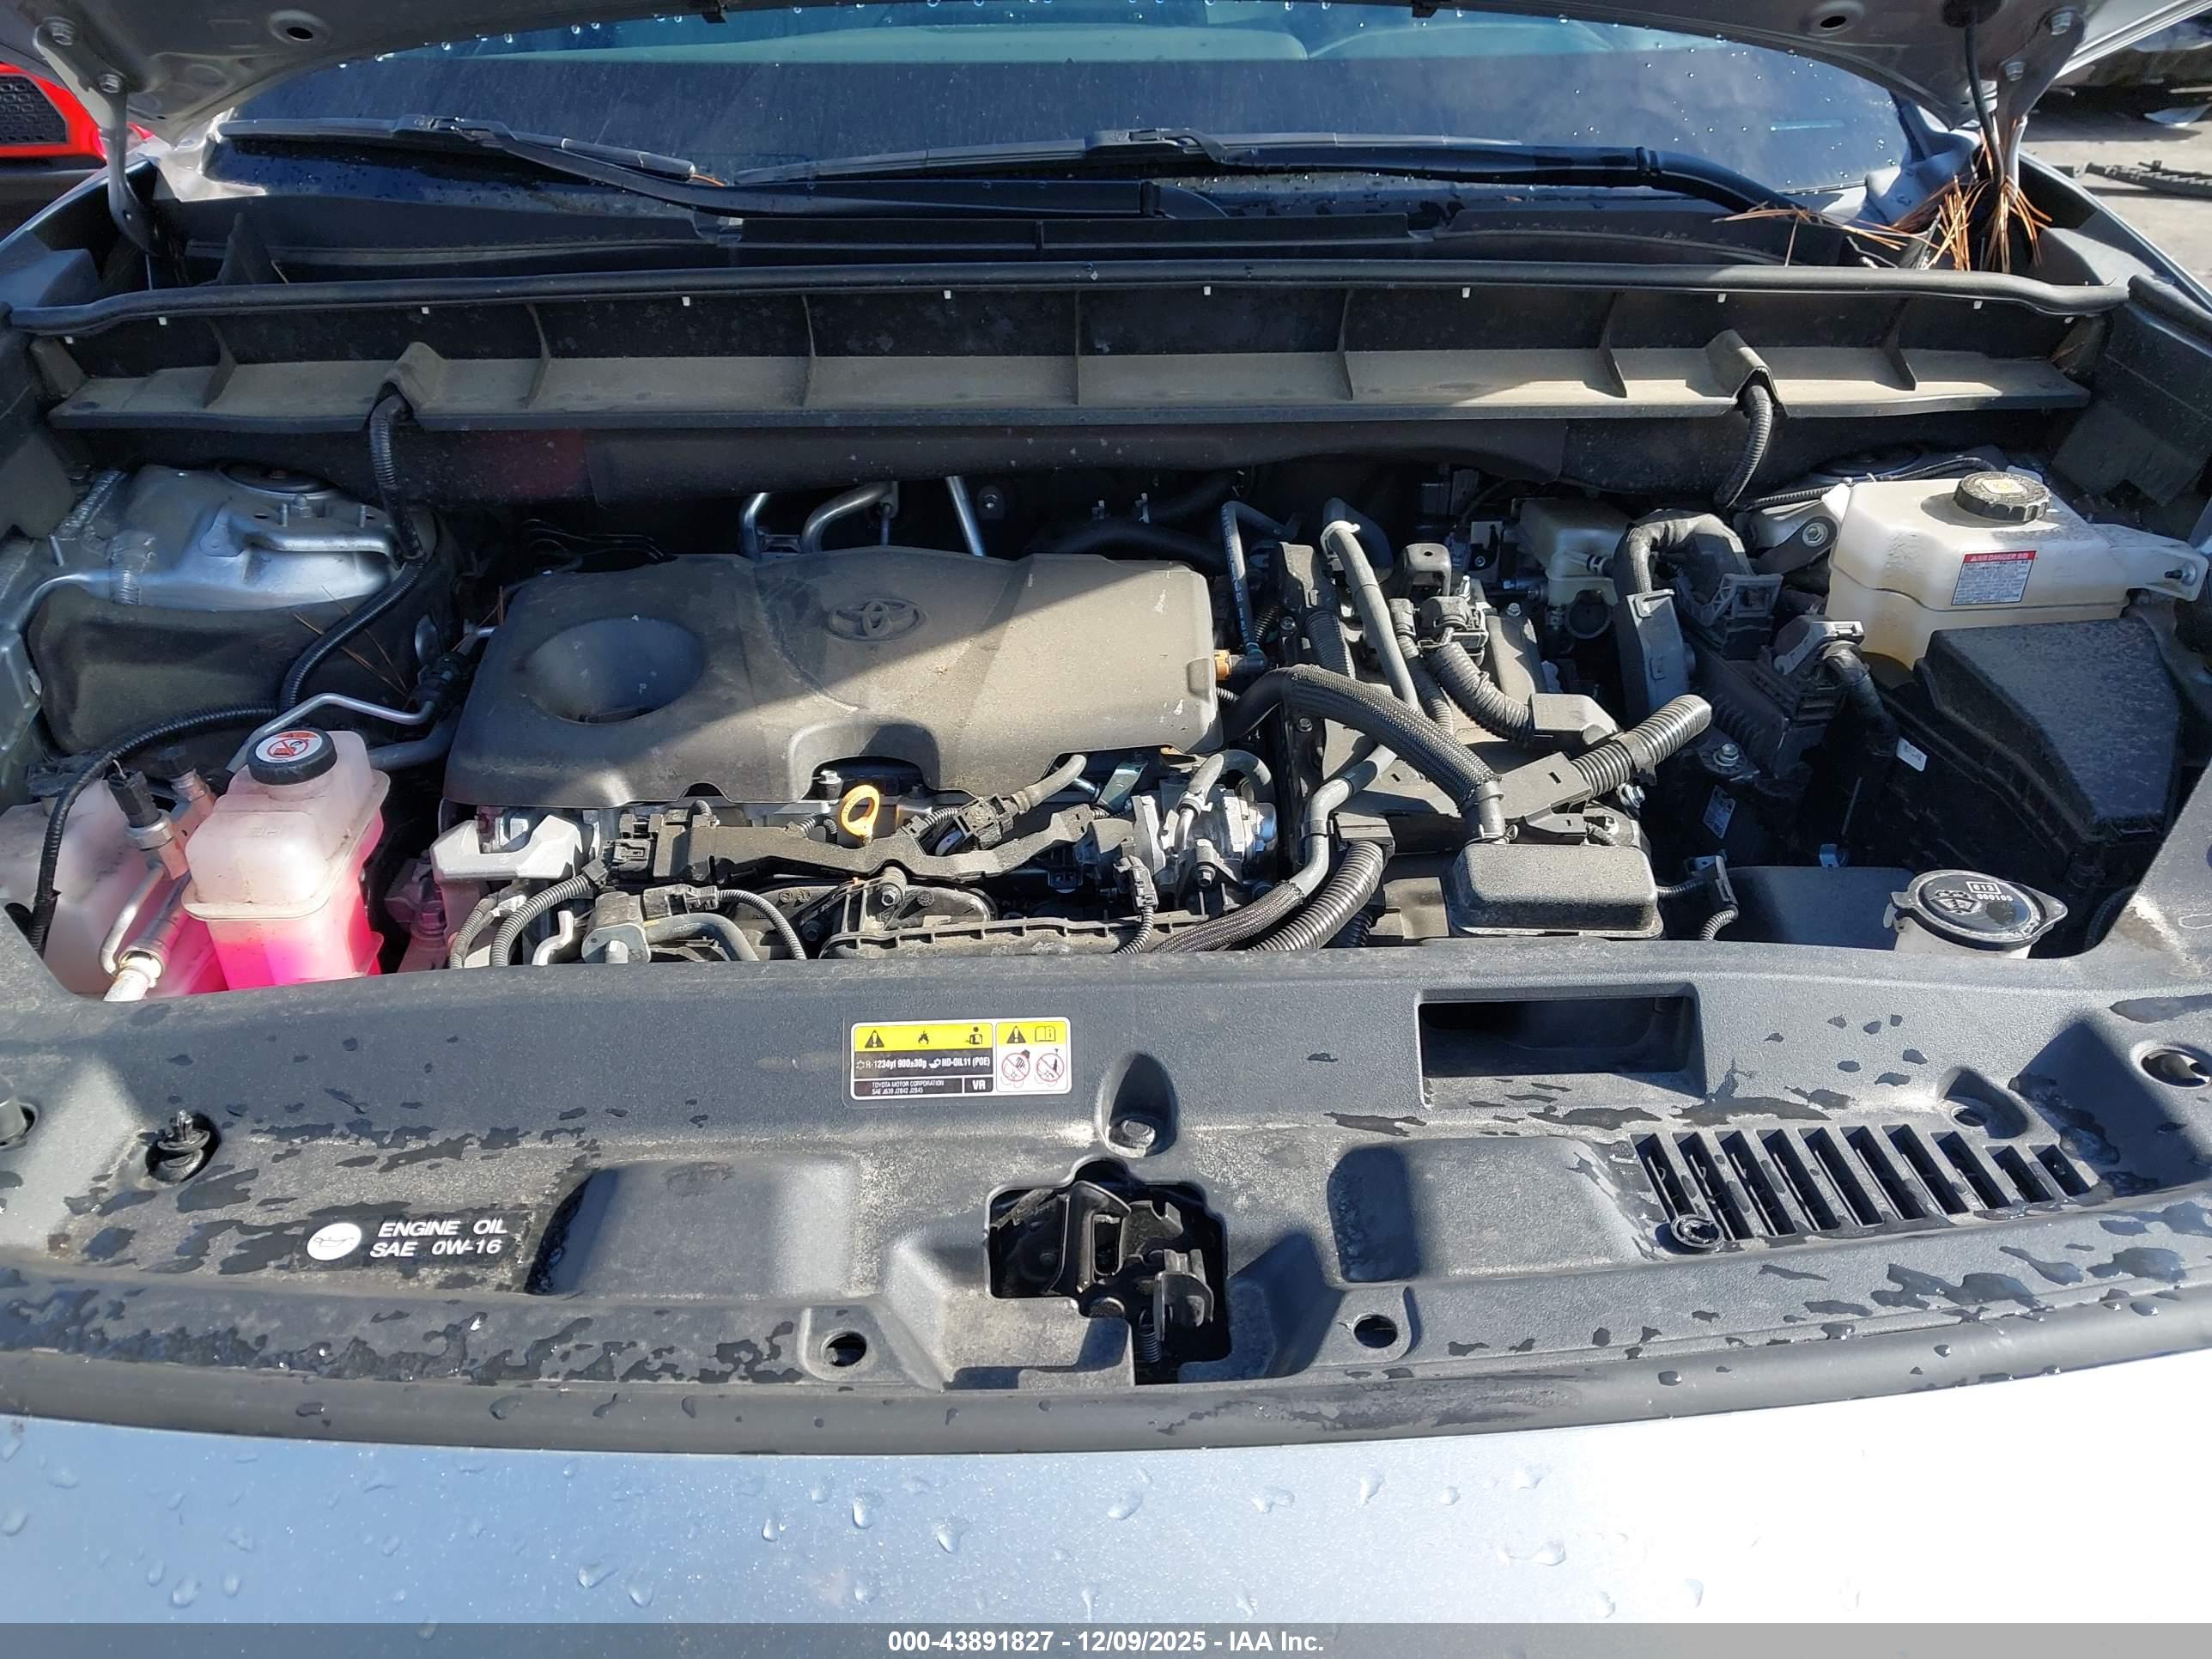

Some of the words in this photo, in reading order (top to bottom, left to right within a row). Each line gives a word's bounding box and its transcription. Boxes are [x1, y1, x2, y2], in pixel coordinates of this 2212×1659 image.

[972, 1056, 990, 1067] (POE)
[972, 1079, 986, 1091] VR
[378, 1220, 461, 1237] ENGINE
[472, 1218, 507, 1234] OIL
[369, 1241, 418, 1258] SAE
[431, 1239, 502, 1255] 0W-16
